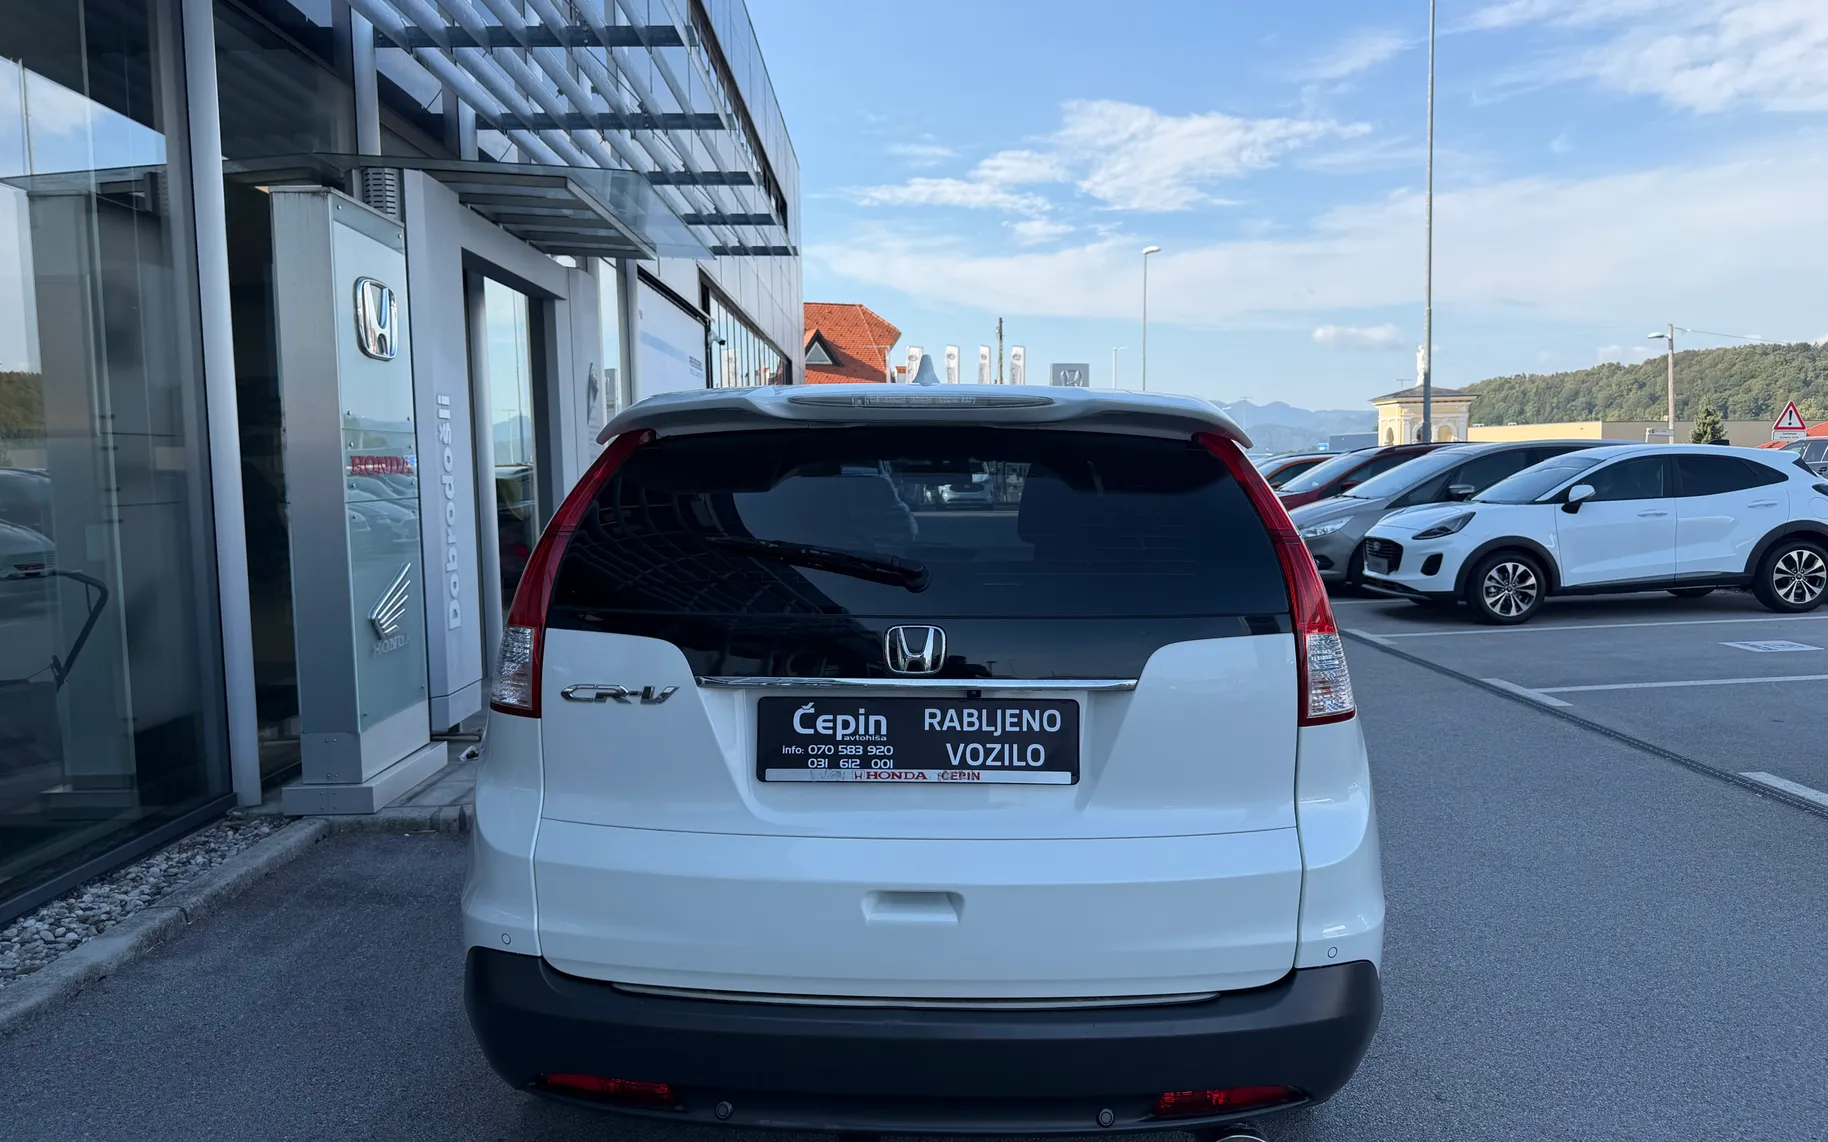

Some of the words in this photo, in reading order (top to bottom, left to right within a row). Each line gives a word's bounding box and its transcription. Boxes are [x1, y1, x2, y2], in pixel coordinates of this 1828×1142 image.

[351, 455, 414, 475] HONDA
[437, 394, 461, 630] Dobrodošli
[560, 683, 680, 704] CR-V
[793, 702, 887, 740] Čepin
[924, 708, 1061, 736] RABLJENO
[782, 745, 804, 754] info:
[808, 745, 834, 755] 070
[838, 745, 863, 755] 583
[867, 745, 893, 755] 920
[946, 743, 1045, 766] VOZILO
[808, 758, 828, 768] 031
[840, 758, 860, 769] 612
[871, 759, 893, 769] 001
[866, 771, 928, 780] HONDA
